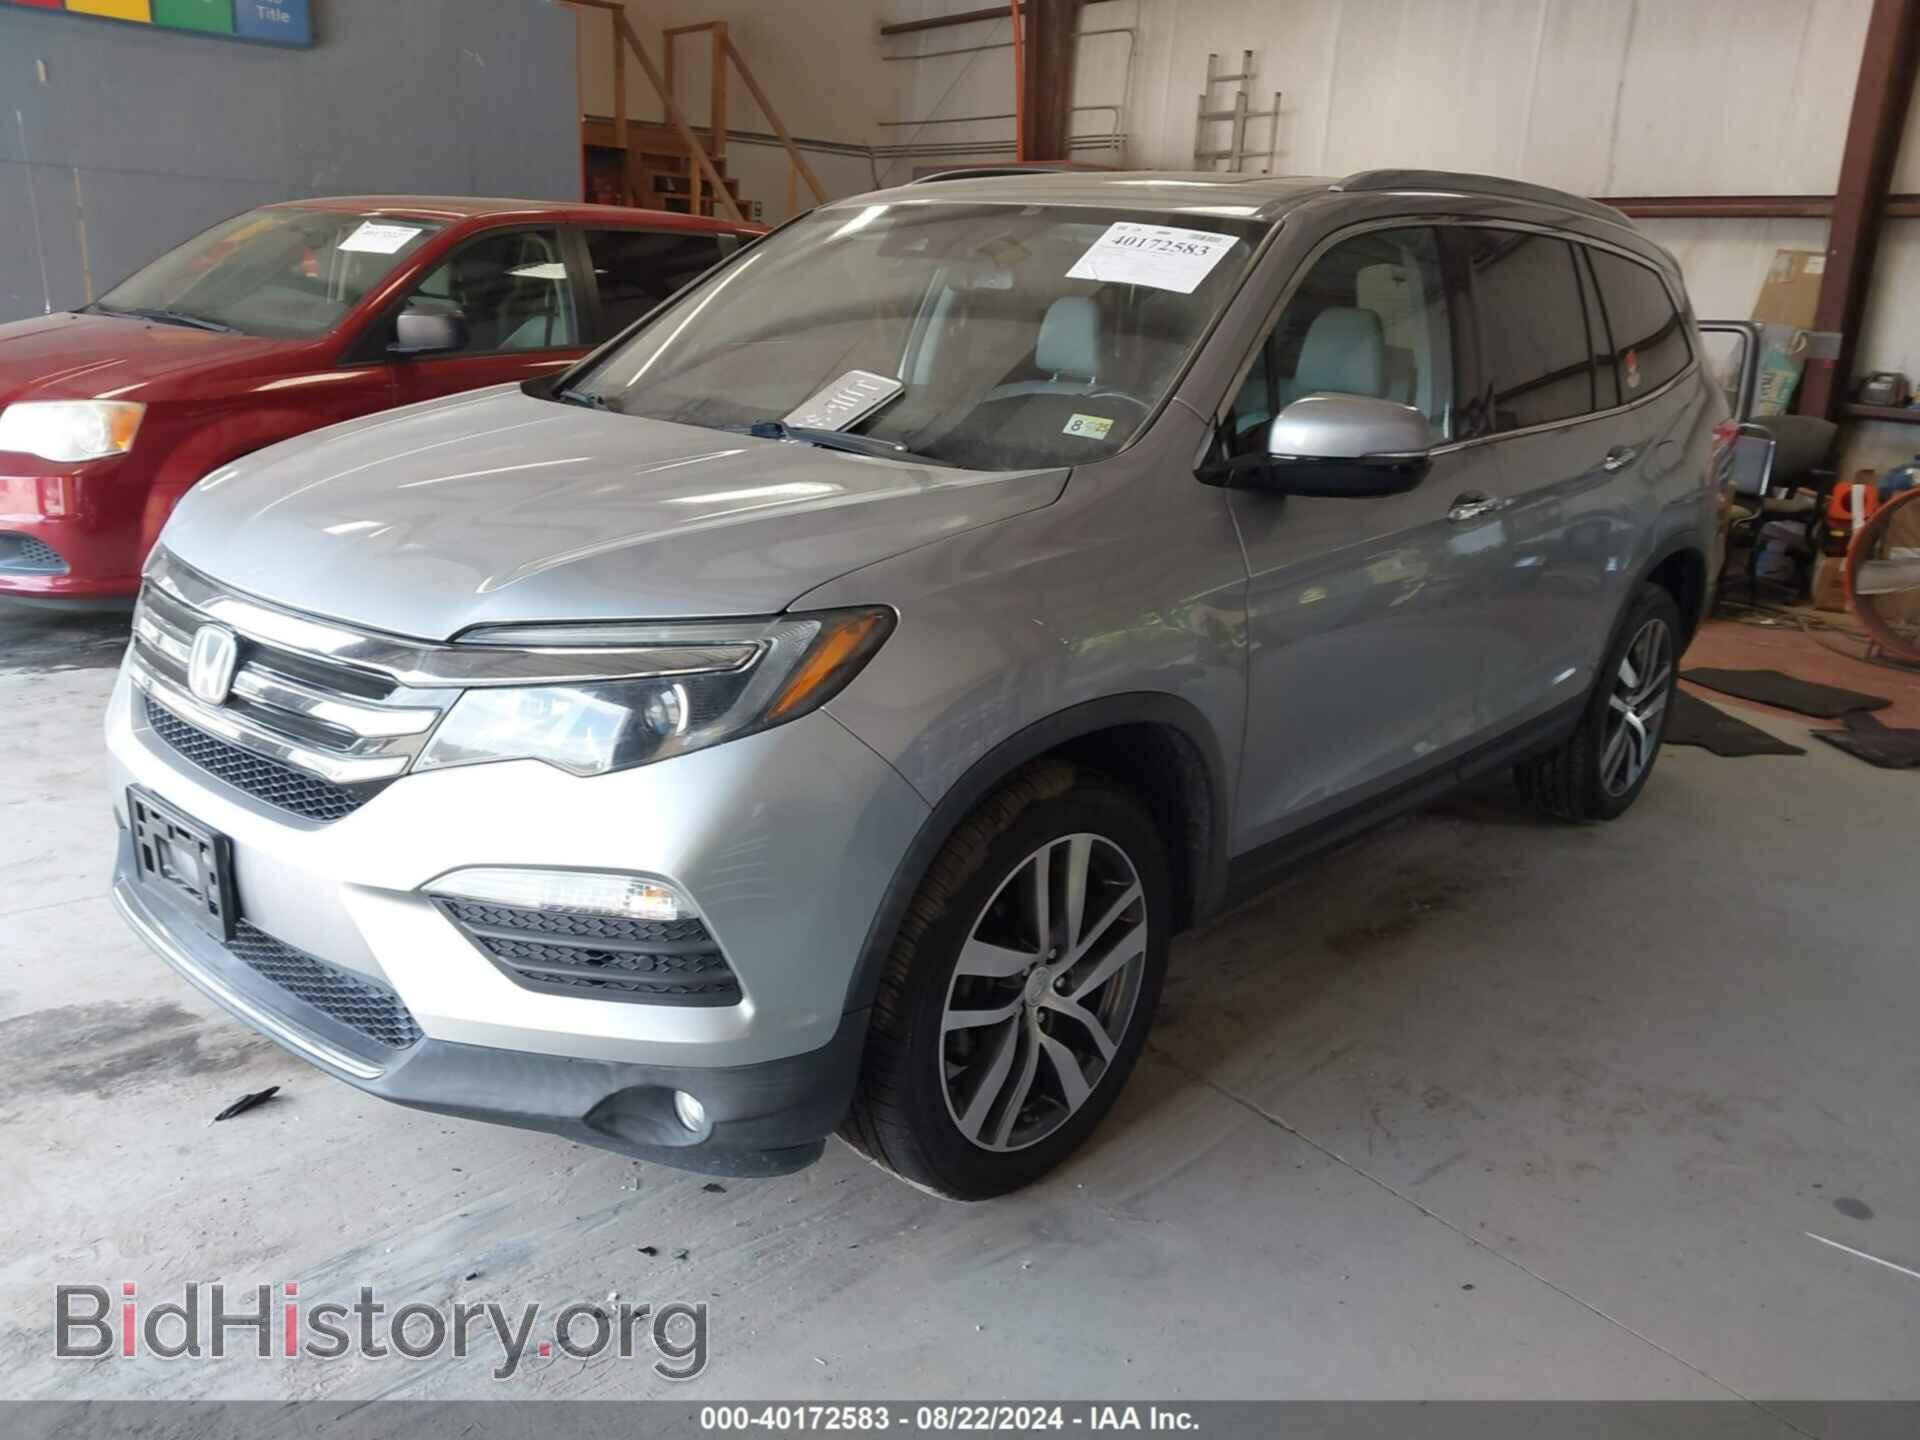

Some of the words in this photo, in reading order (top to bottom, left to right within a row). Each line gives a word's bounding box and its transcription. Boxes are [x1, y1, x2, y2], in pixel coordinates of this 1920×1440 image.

[257, 5, 290, 22] Title
[1112, 235, 1210, 257] 40172583
[1070, 419, 1084, 432] 8
